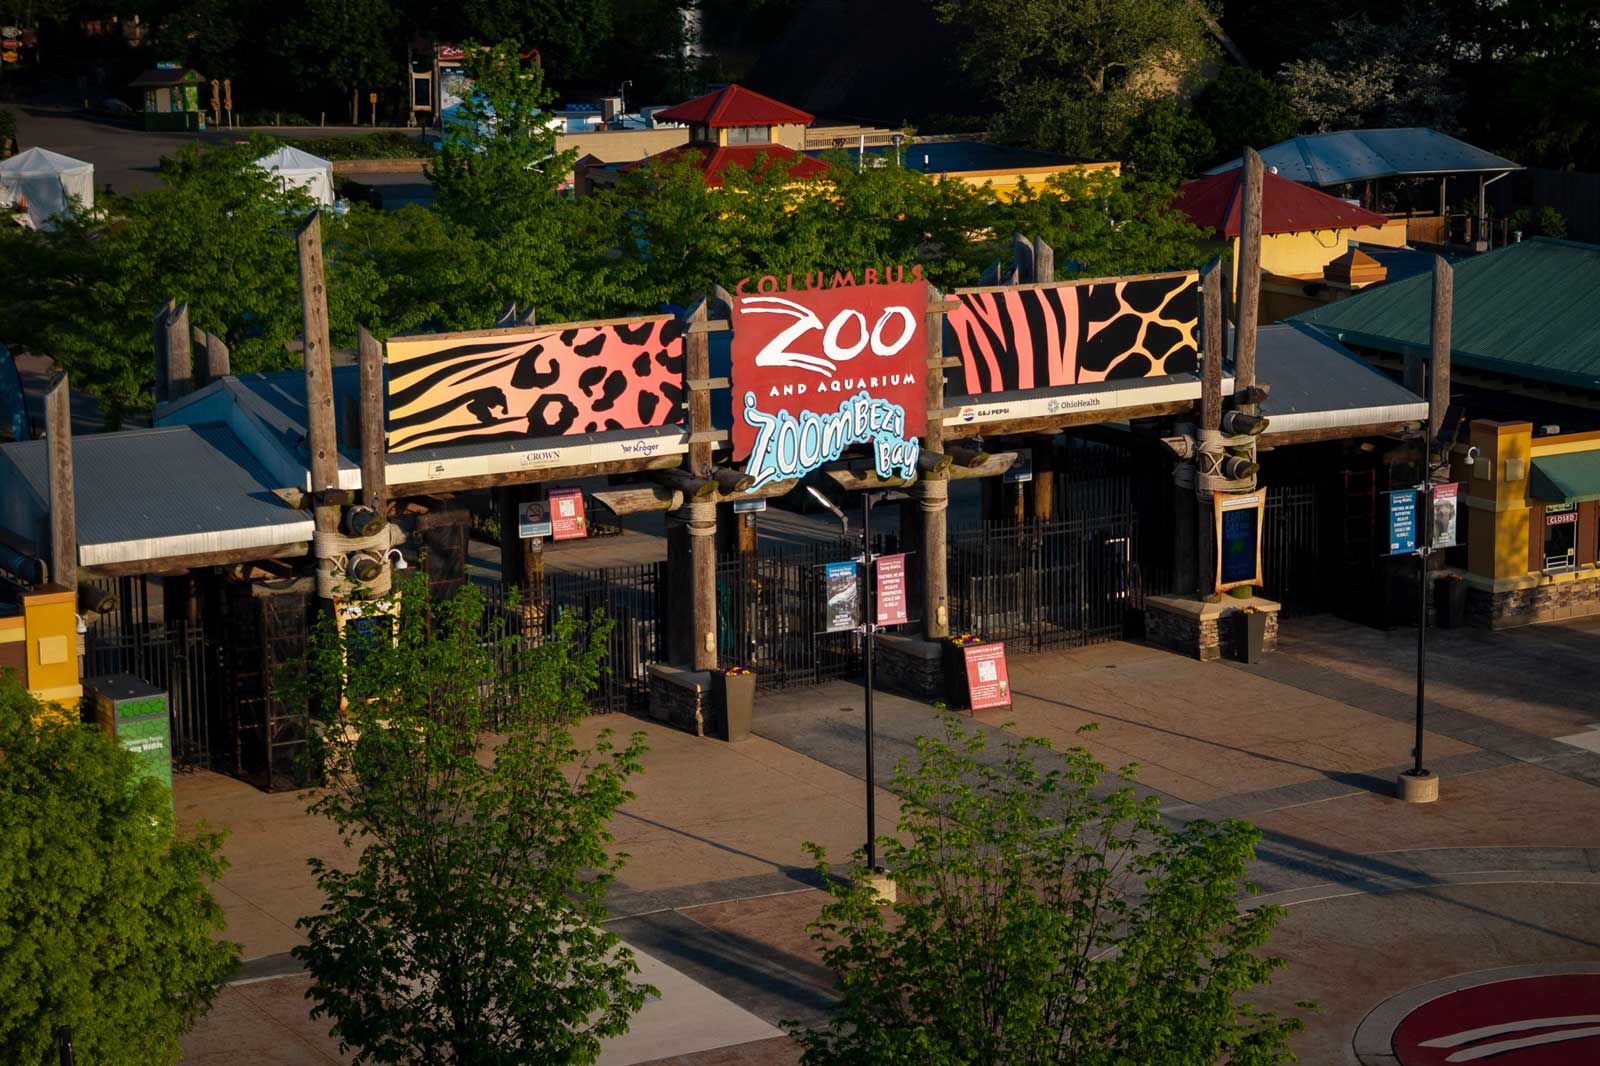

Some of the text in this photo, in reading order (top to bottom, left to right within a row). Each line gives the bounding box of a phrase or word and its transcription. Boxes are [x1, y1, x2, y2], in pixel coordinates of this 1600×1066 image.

[736, 264, 923, 296] COLUMBUS
[741, 296, 917, 378] ZOO
[769, 374, 916, 397] AND AQUARIUM
[1061, 398, 1100, 409] OhioHealth
[526, 450, 561, 461] CROWN
[1550, 514, 1575, 524] CLOSED
